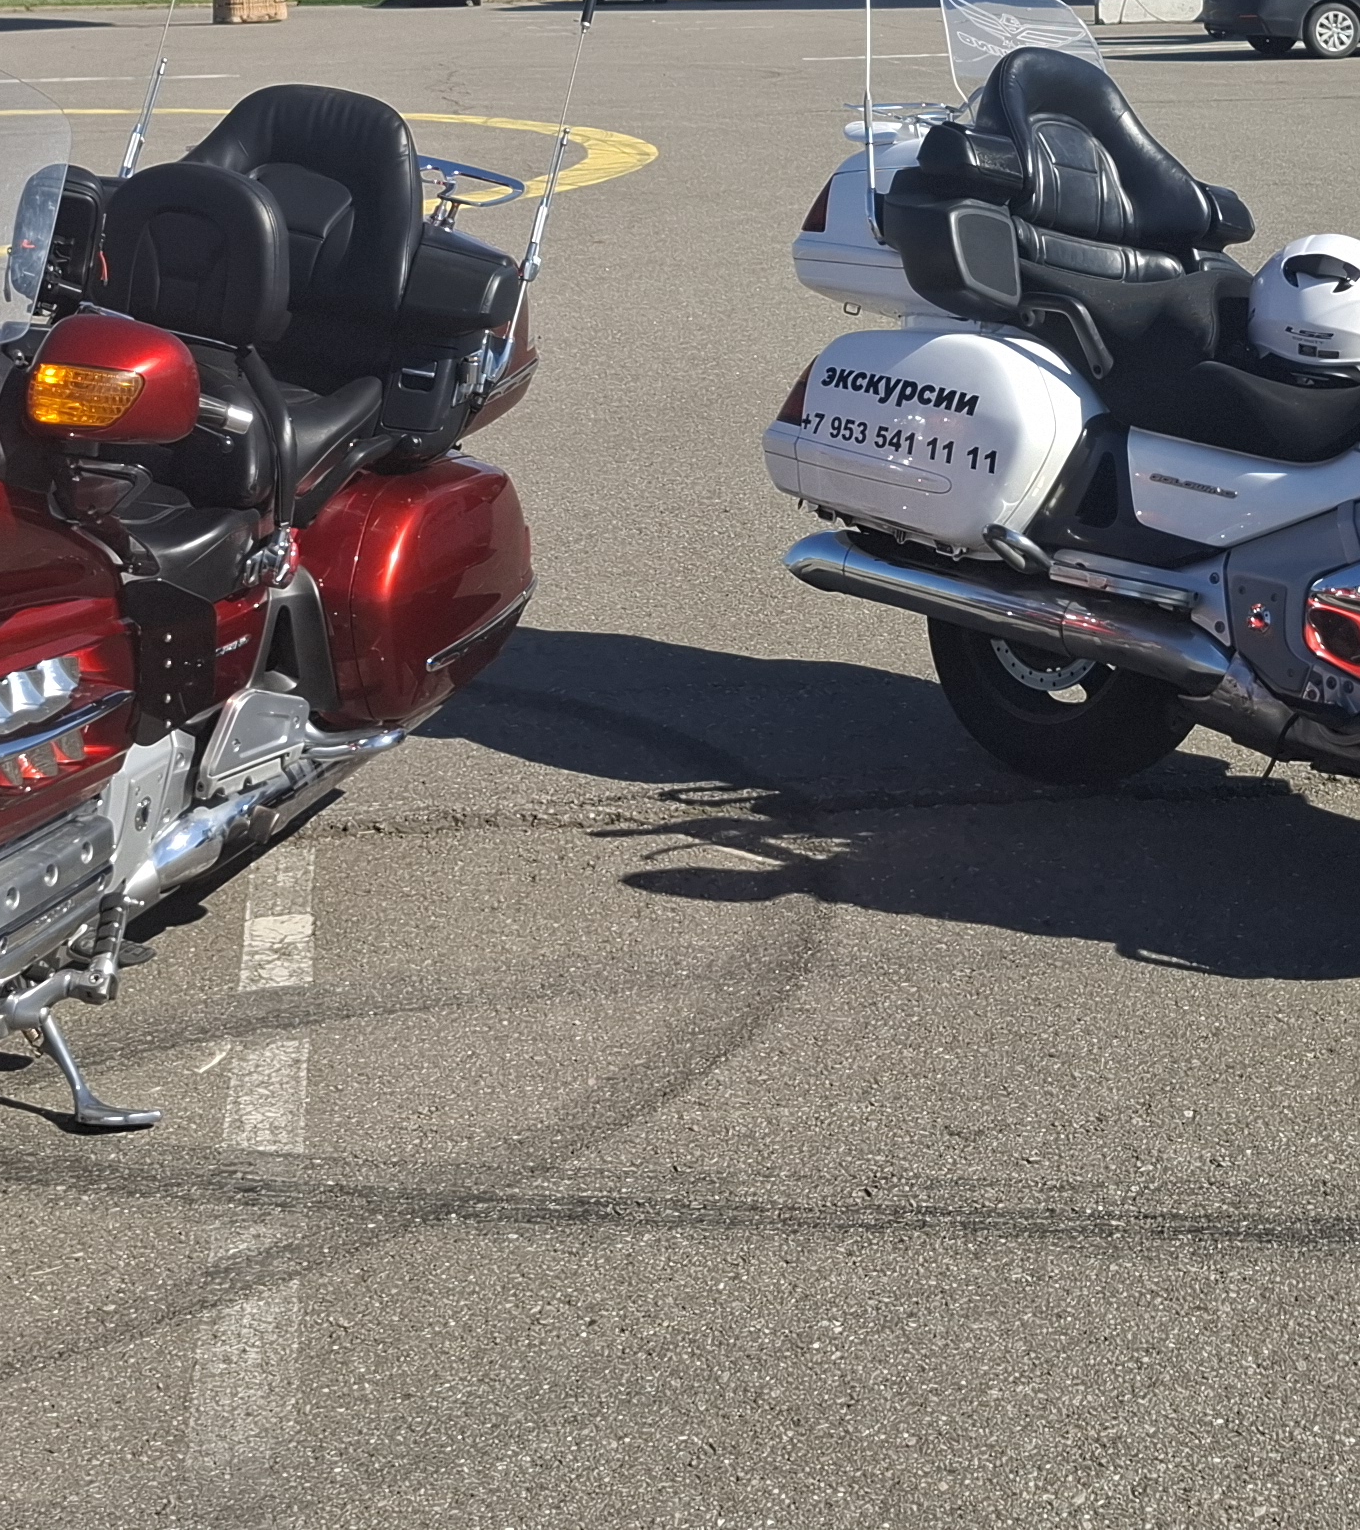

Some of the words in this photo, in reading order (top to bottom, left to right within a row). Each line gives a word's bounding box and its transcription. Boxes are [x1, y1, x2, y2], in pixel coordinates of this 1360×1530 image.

[1285, 326, 1335, 340] LS2
[801, 412, 826, 435] +7
[829, 416, 868, 445] 953
[874, 426, 915, 456] 541
[926, 436, 956, 465] 11
[966, 445, 998, 475] 11
